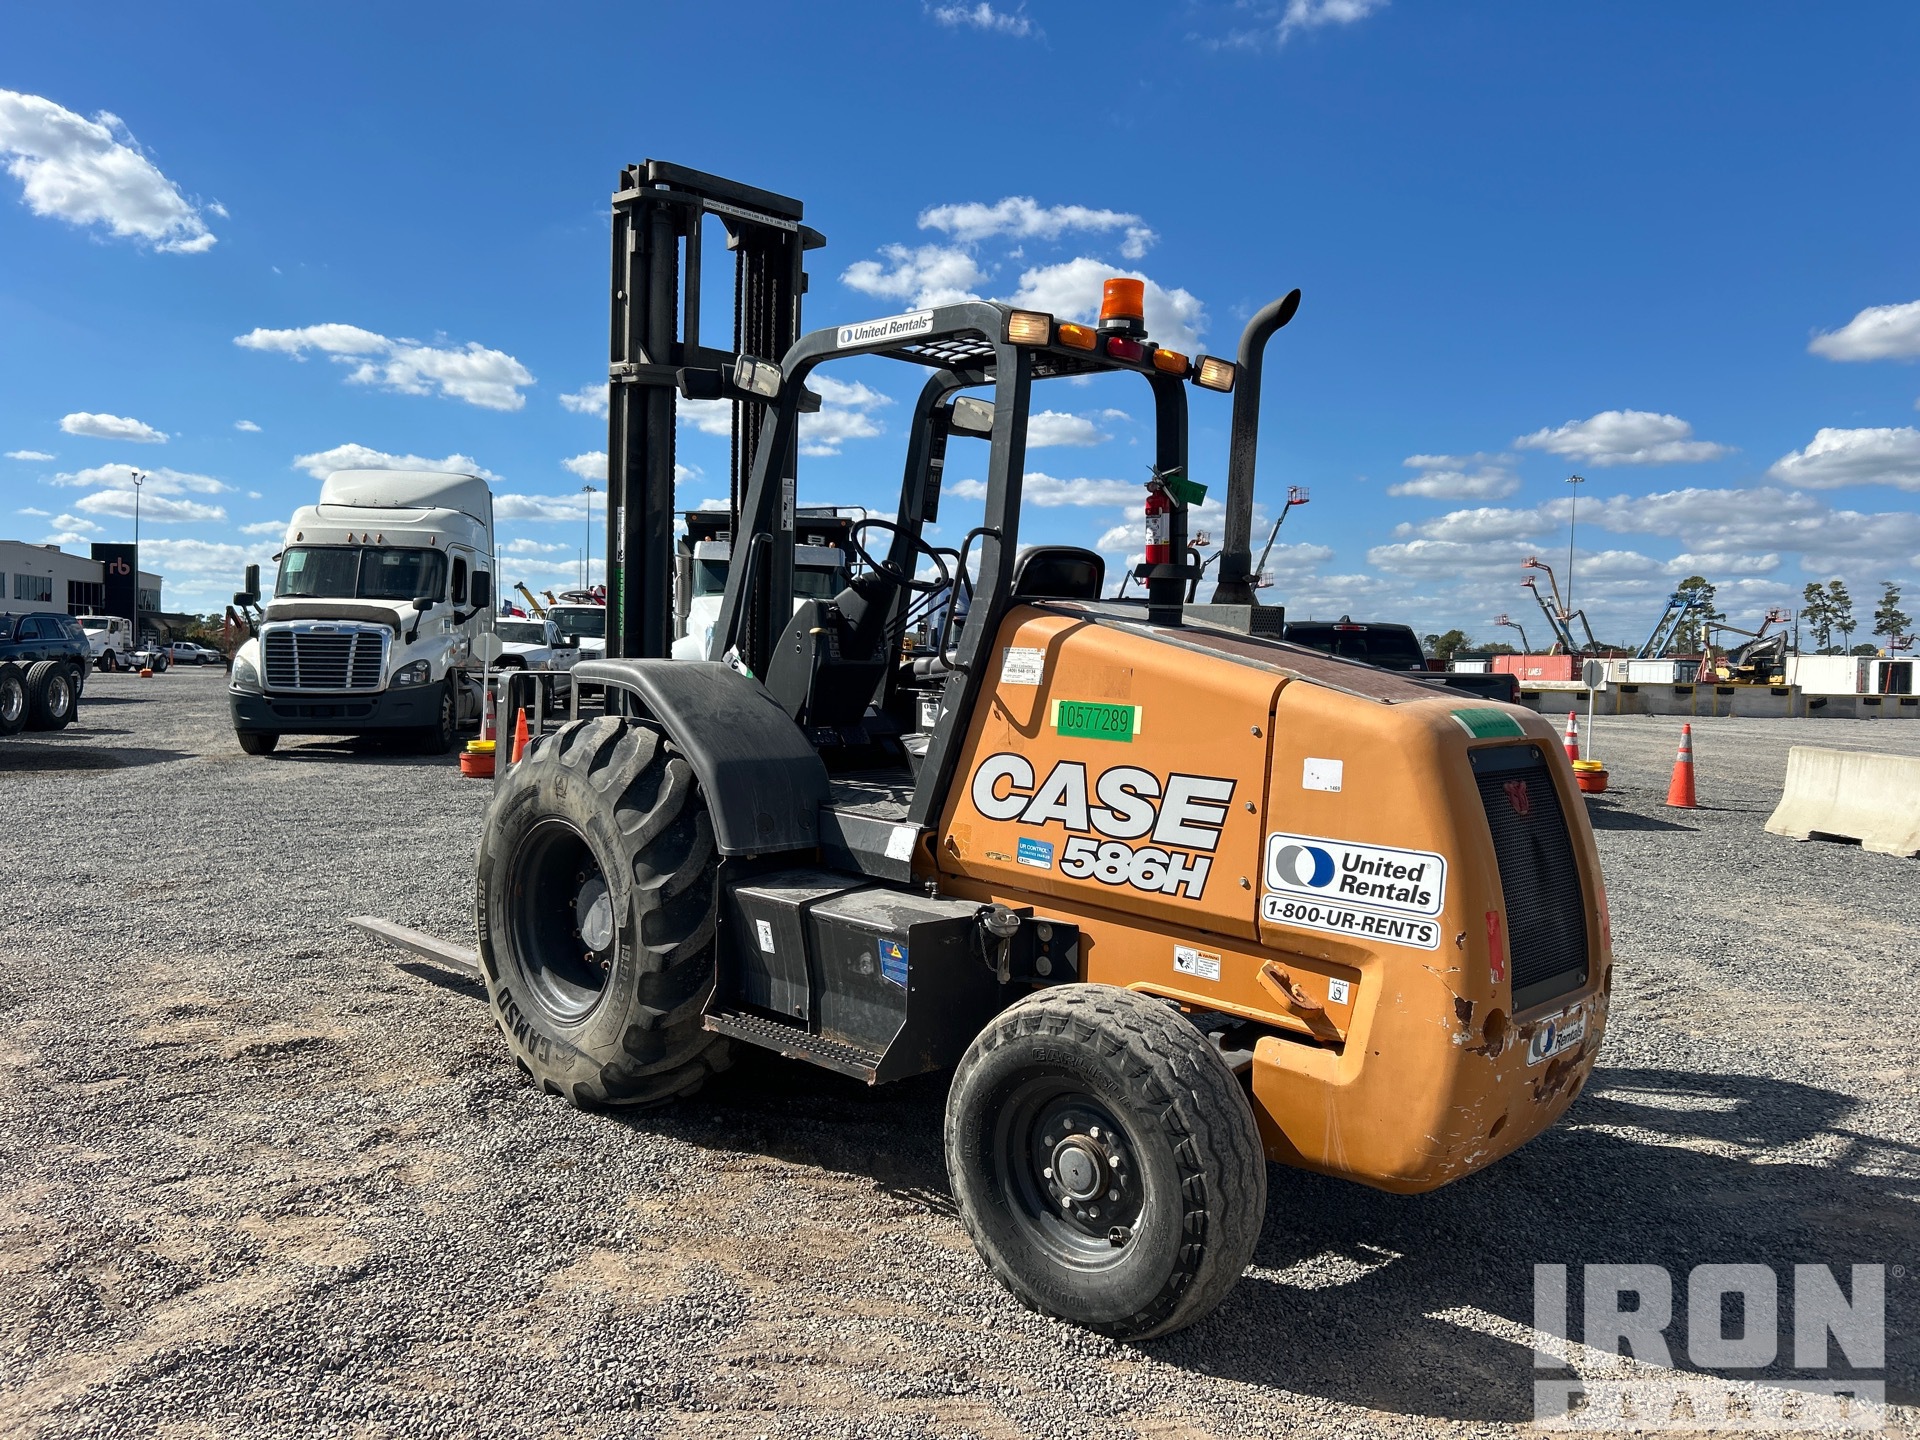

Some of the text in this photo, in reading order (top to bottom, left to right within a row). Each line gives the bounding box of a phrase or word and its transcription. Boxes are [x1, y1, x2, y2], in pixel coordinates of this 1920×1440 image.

[854, 316, 928, 340] United Rentals
[109, 556, 131, 576] rb
[1528, 667, 1542, 676] LINES
[1060, 705, 1129, 733] 10577289
[972, 752, 1237, 850] CASE
[1026, 845, 1048, 854] CONTROL
[1059, 835, 1213, 900] 586H
[1341, 852, 1425, 883] United
[1338, 873, 1432, 906] Rentals
[478, 878, 488, 941] BHL 532
[1269, 901, 1432, 942] 1-800-UR-RENTS
[496, 986, 553, 1067] CAMSO
[1554, 1025, 1583, 1050] Rentals
